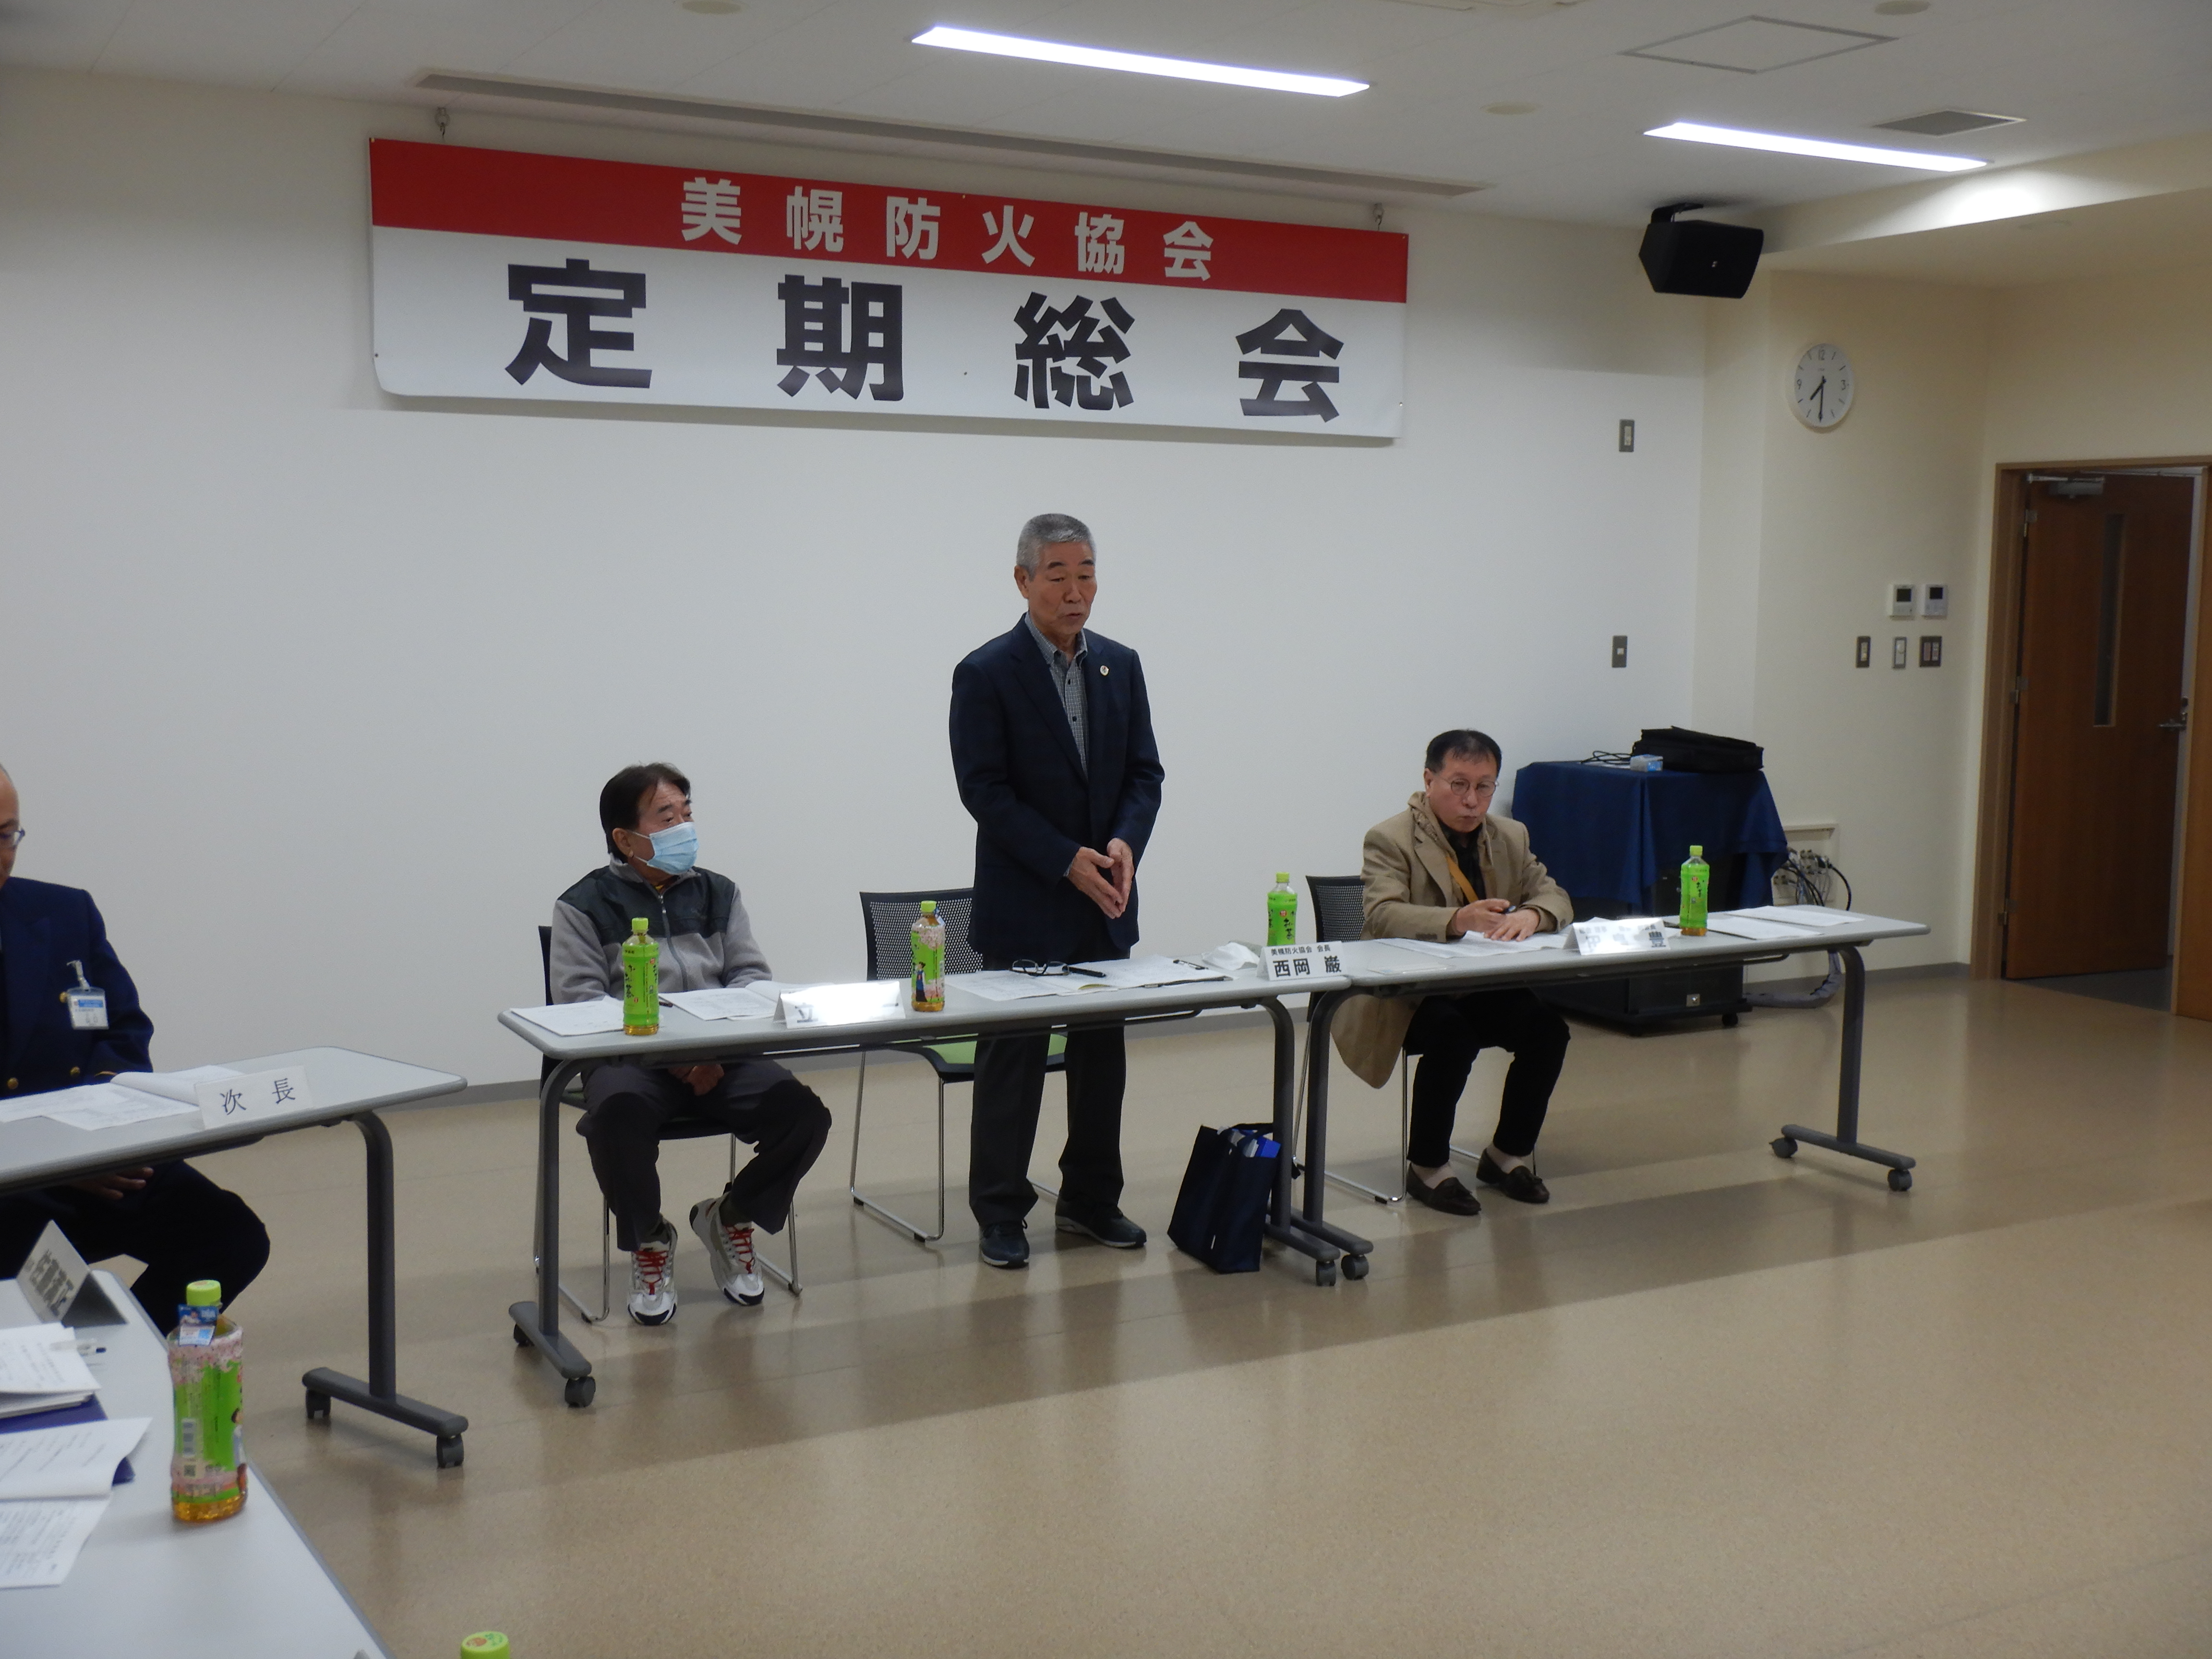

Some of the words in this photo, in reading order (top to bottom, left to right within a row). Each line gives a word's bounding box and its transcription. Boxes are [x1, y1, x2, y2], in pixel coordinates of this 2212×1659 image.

[681, 177, 1214, 282] 美幌防火協会
[505, 258, 1344, 422] 定期総会
[1797, 379, 1802, 390] 9
[1841, 379, 1846, 390] 3
[1273, 958, 1310, 977] 西岡
[219, 1077, 296, 1115] 次長
